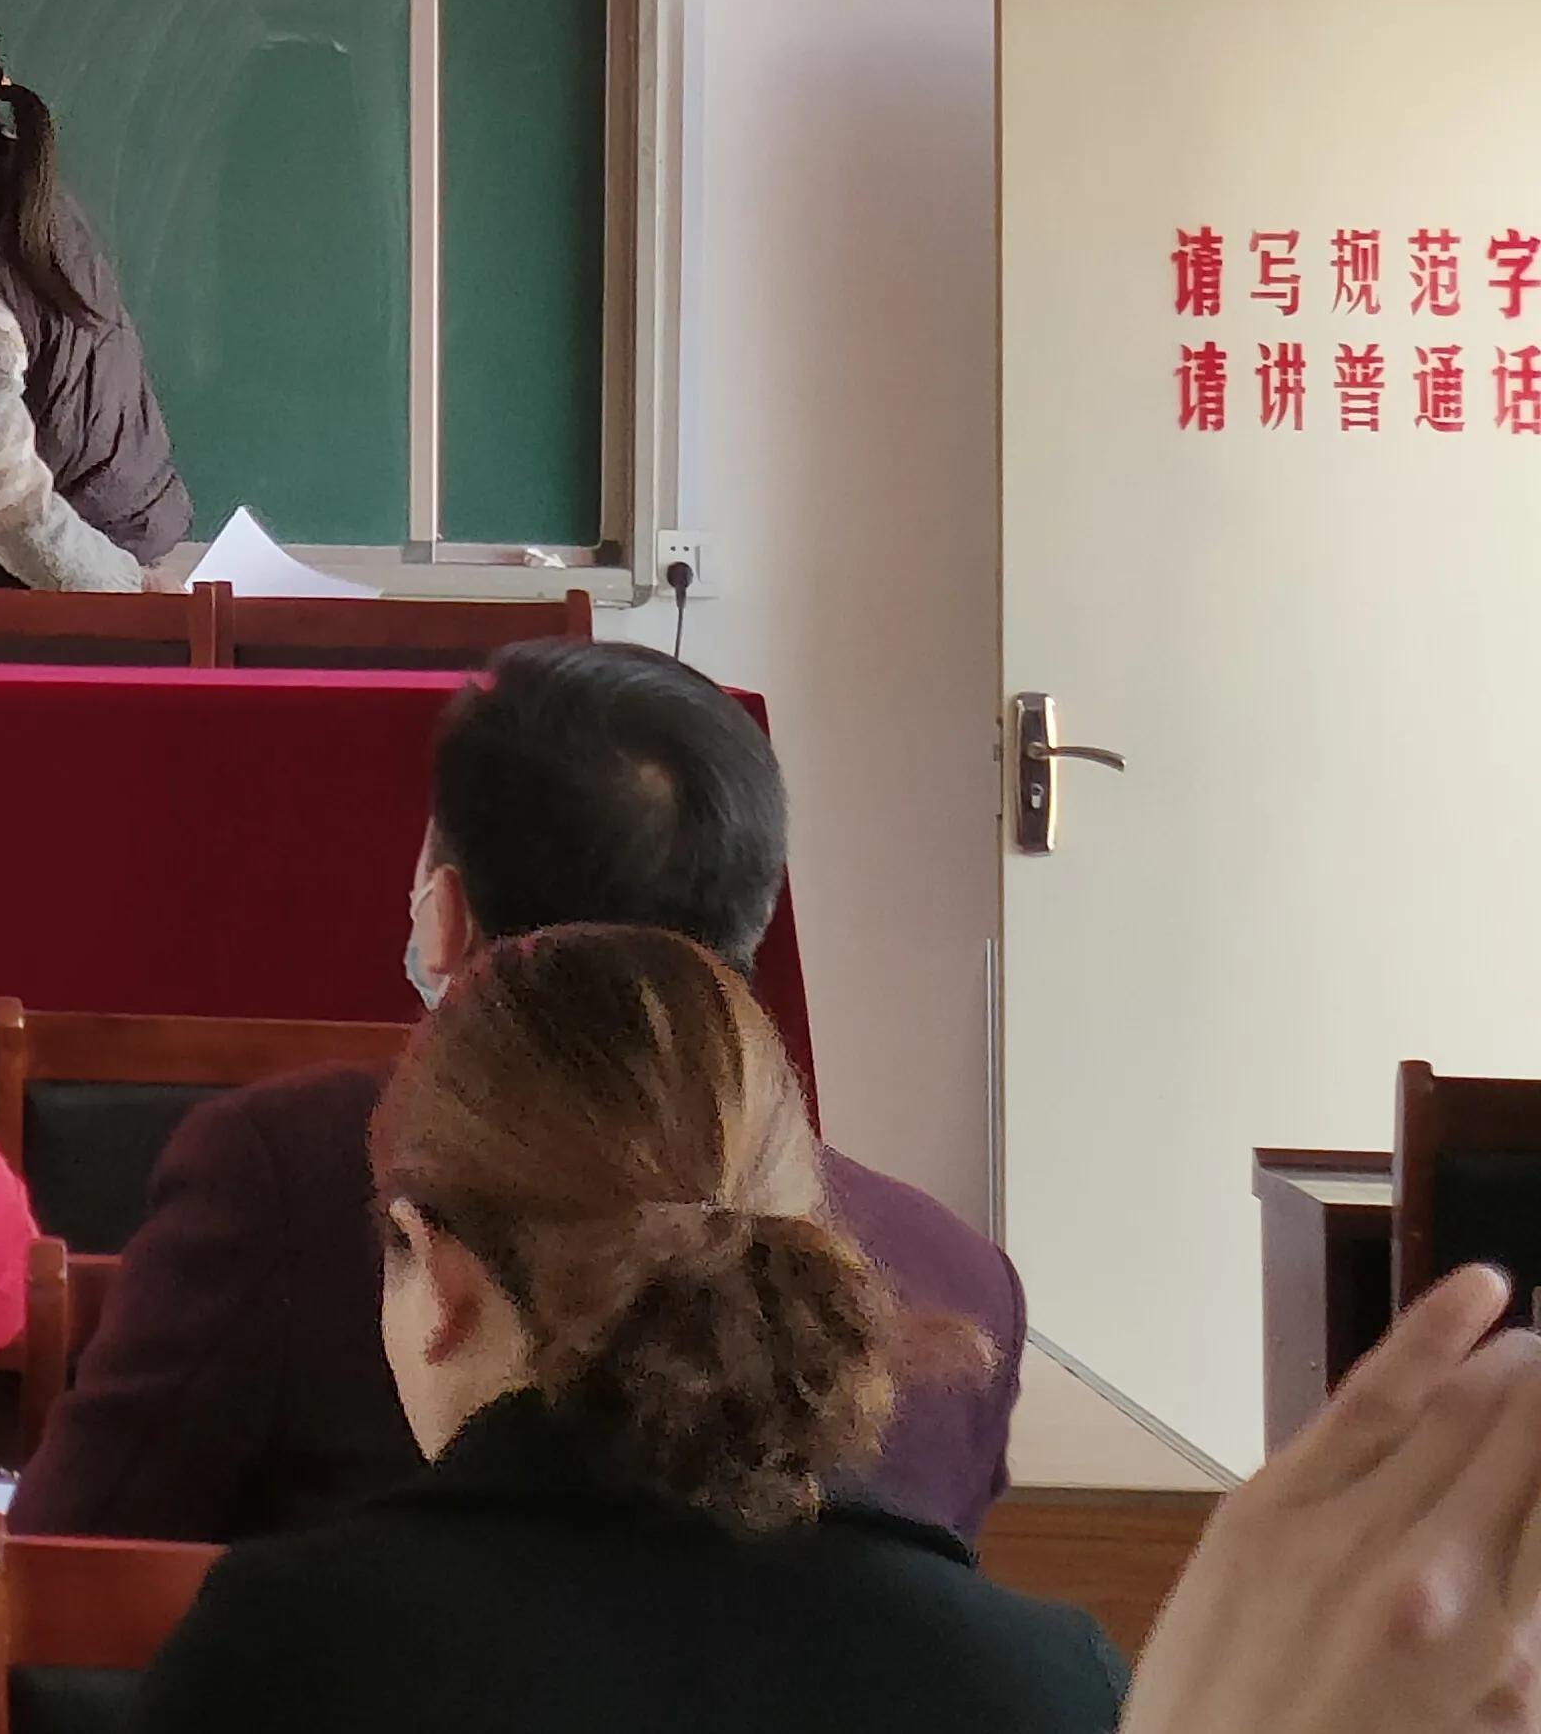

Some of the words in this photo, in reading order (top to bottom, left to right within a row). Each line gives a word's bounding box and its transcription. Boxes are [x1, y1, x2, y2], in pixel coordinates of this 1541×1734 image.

[1169, 225, 1541, 319] 请写规范字
[1172, 340, 1541, 436] 请讲普通话
